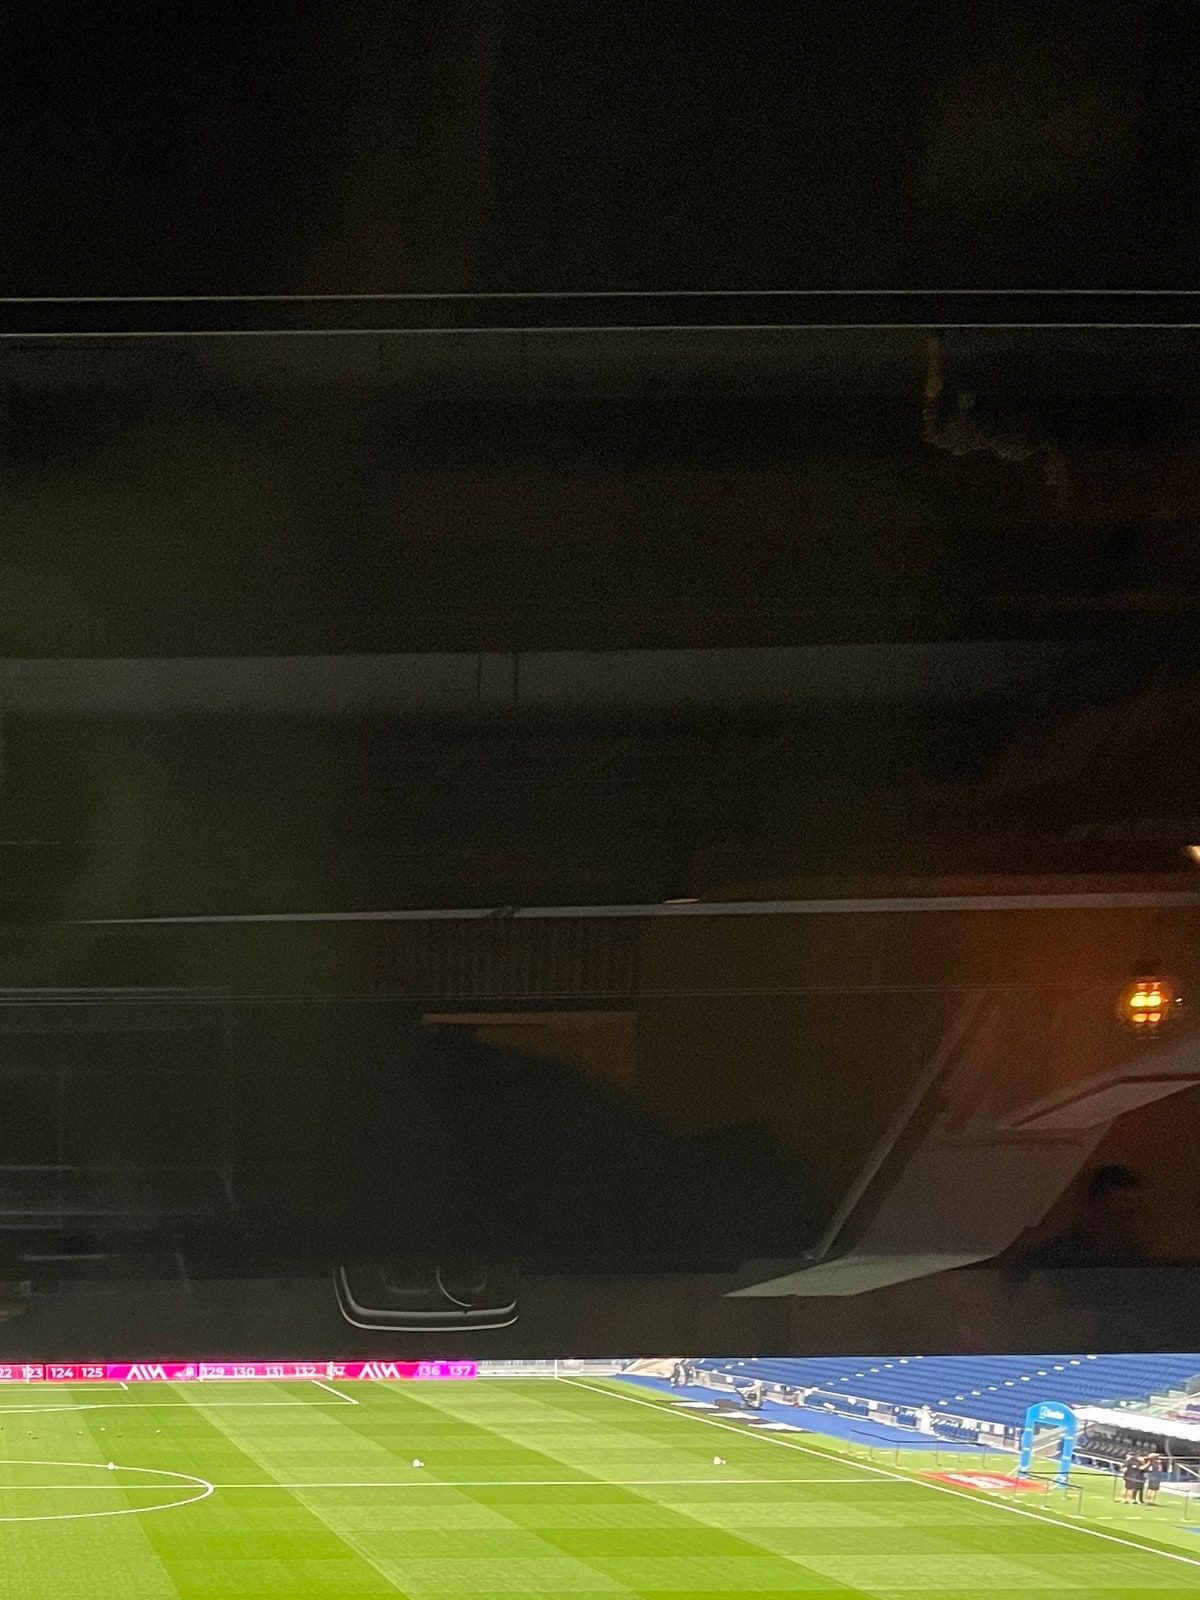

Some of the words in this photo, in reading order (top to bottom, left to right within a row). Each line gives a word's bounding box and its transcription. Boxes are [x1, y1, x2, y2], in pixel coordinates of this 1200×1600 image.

[21, 1367, 43, 1378] 123
[50, 1367, 74, 1378] 124
[81, 1367, 104, 1377] 125
[203, 1367, 225, 1377] 129
[233, 1367, 256, 1377] 130
[264, 1366, 284, 1376] 131
[294, 1366, 316, 1376] 132
[448, 1366, 471, 1376] 137
